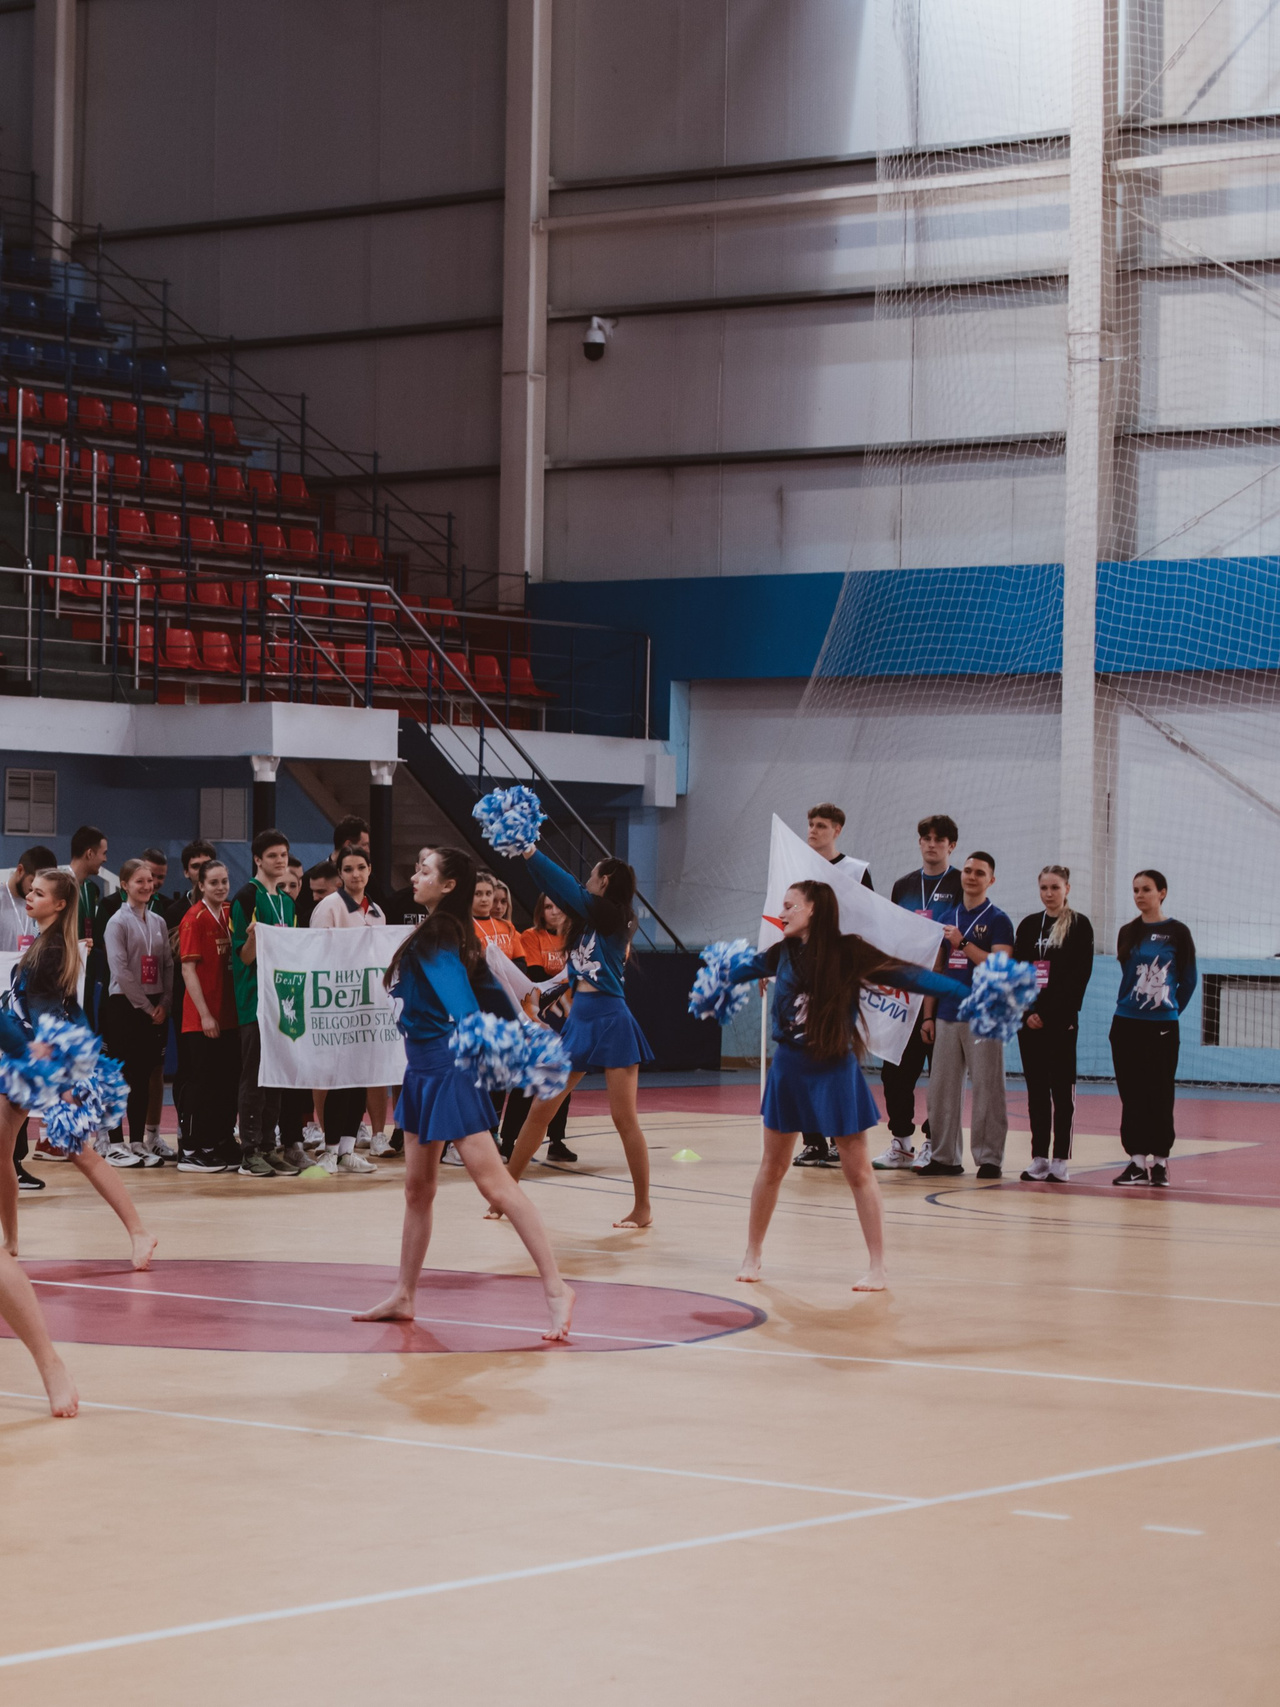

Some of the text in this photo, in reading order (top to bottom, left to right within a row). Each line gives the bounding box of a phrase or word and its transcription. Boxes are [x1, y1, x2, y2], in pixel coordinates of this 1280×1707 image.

[275, 972, 305, 985] БелГУ
[335, 969, 363, 984] НИУ
[311, 1012, 398, 1030] BELGOD STA
[312, 1029, 377, 1046] UNIVESITY
